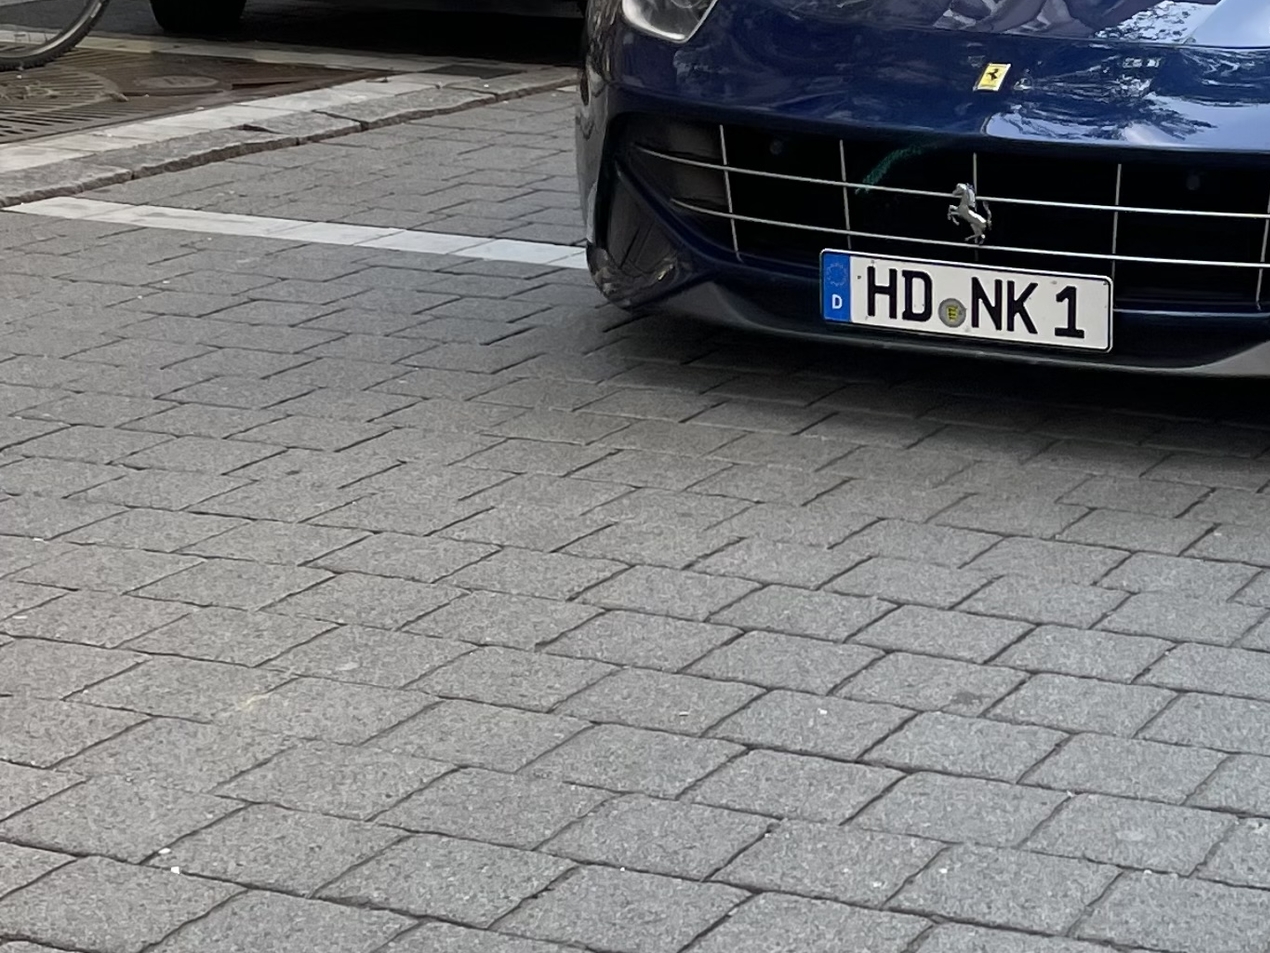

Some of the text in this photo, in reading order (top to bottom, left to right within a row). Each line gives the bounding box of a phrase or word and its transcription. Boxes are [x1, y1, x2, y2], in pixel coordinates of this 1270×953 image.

[832, 266, 1085, 339] D HD NK 1
